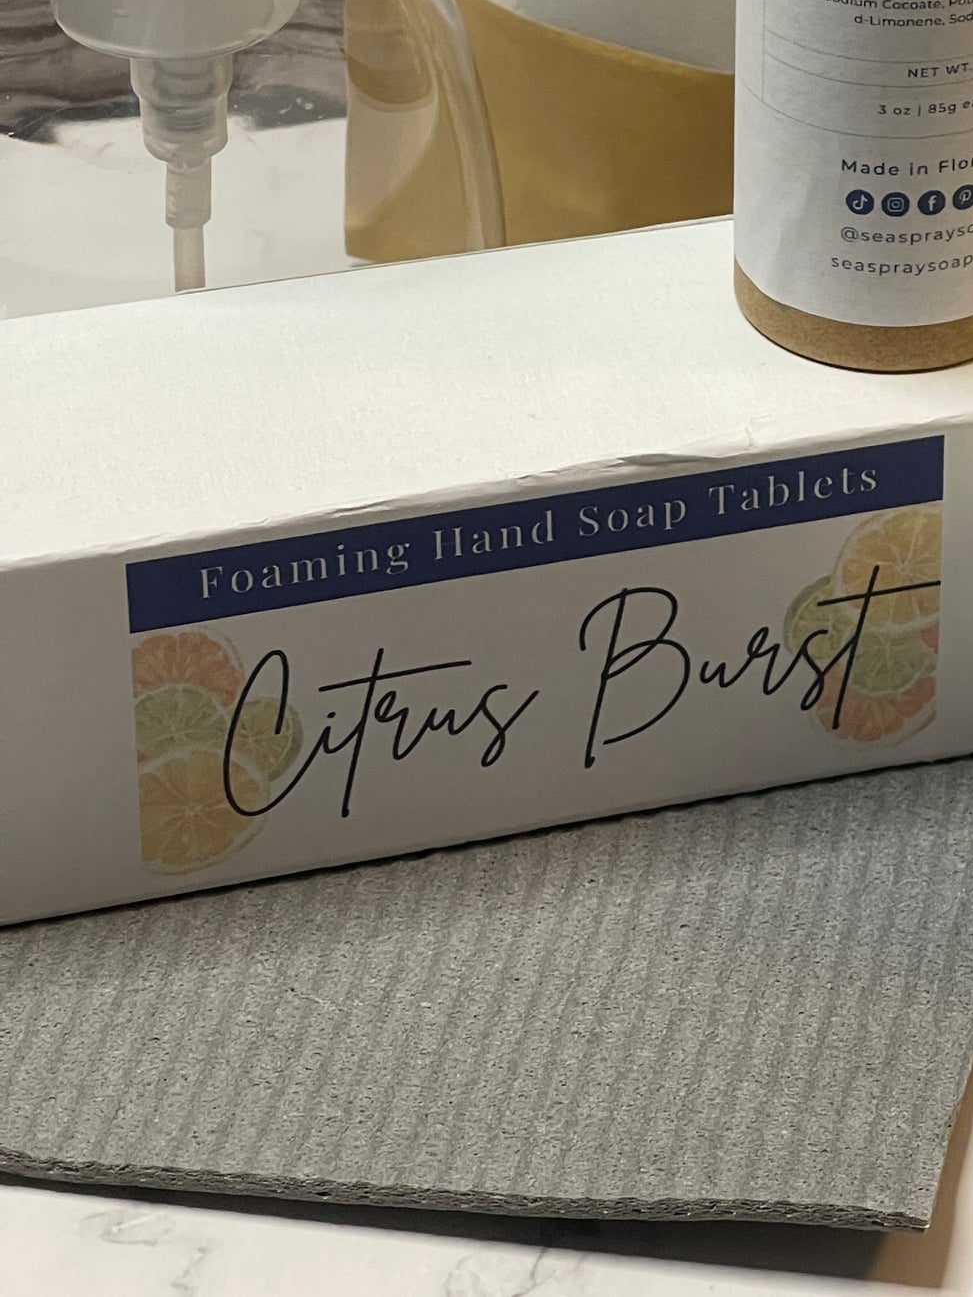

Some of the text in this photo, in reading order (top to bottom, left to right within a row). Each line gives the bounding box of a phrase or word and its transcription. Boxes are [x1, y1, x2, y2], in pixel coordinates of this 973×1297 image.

[882, 0, 944, 10] Cocoate,
[854, 15, 945, 27] d-Limonene,
[908, 63, 973, 78] NET WT.
[878, 105, 886, 114] 3
[928, 103, 956, 114] 85g
[842, 159, 899, 175] Made
[910, 163, 928, 175] in
[201, 468, 876, 598] Foaming Hand Soap Tablets
[223, 565, 941, 818] Citrus Burst
